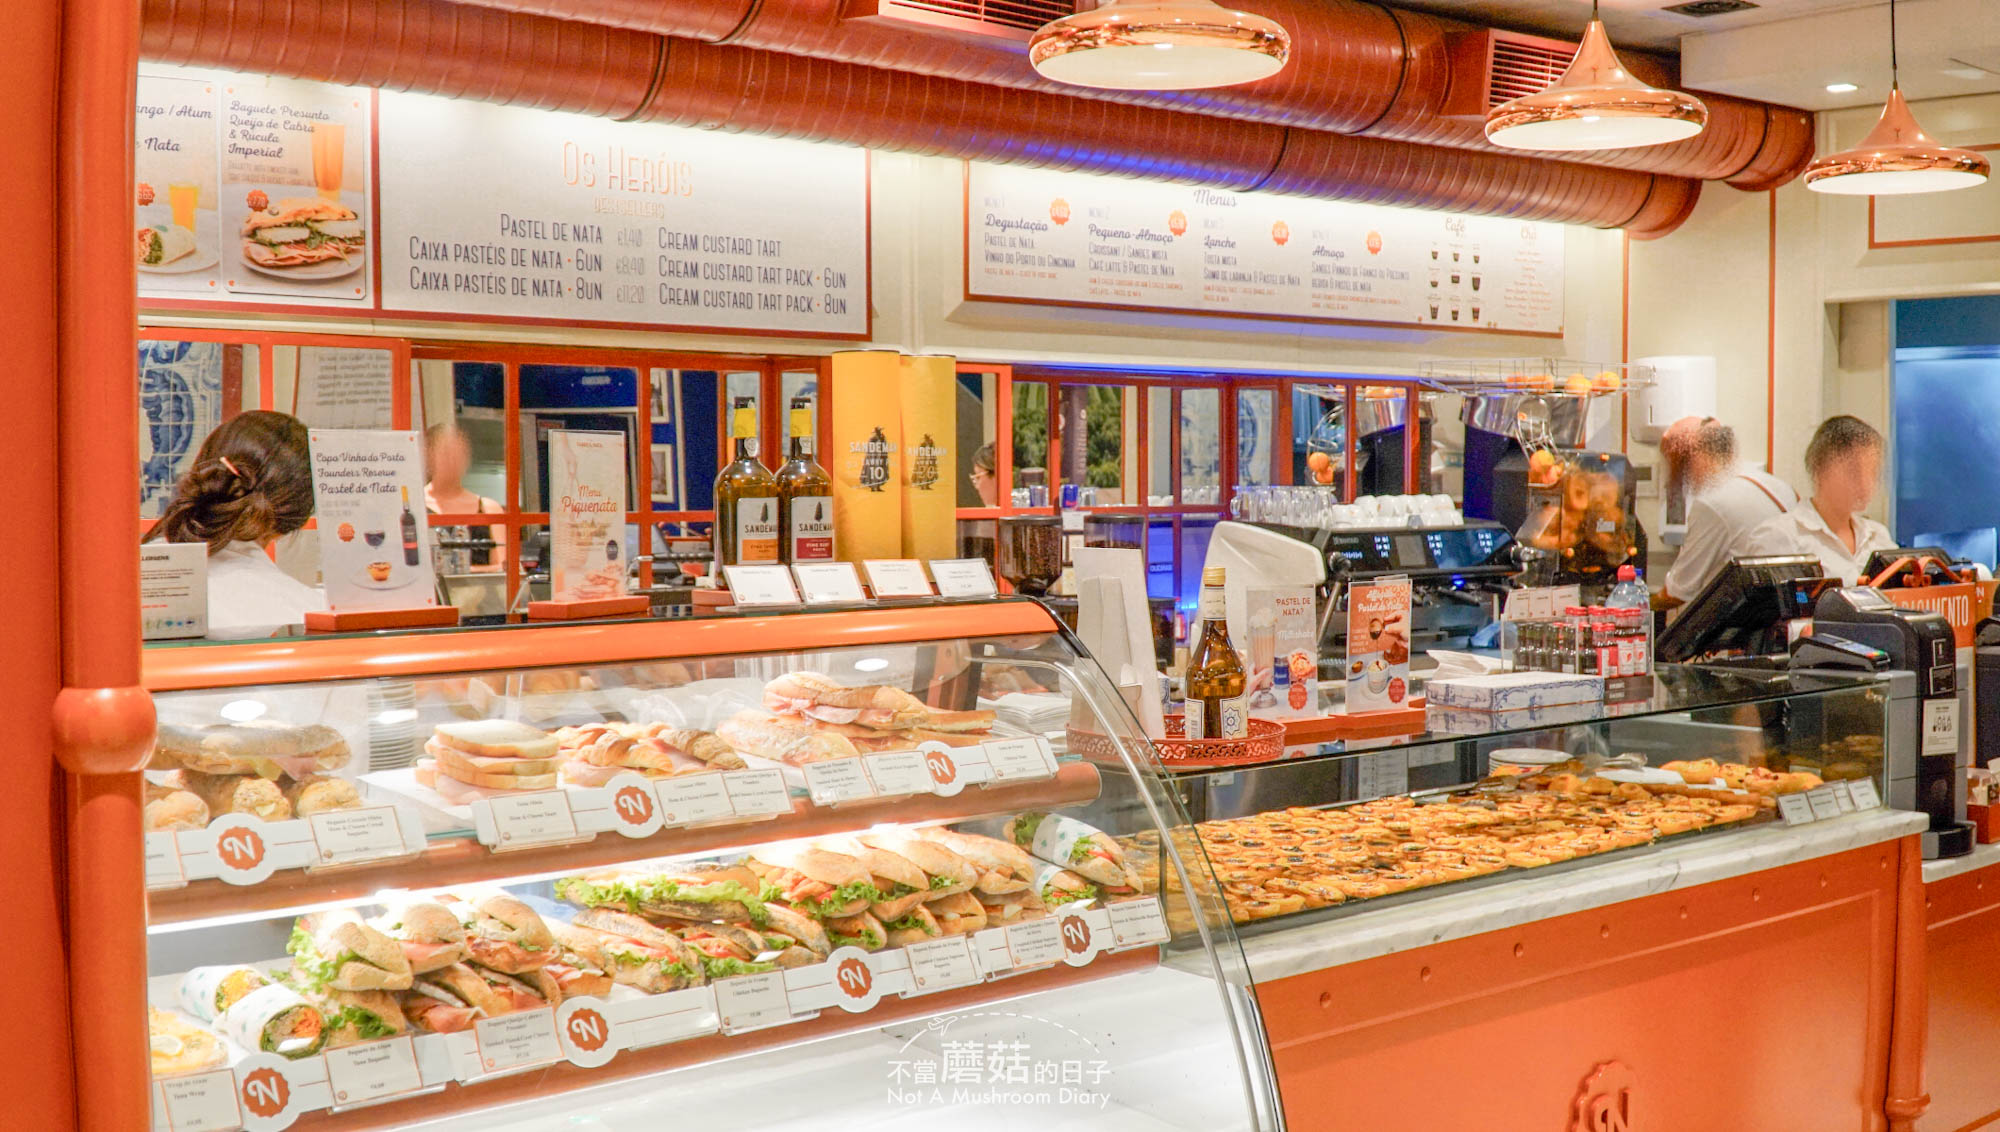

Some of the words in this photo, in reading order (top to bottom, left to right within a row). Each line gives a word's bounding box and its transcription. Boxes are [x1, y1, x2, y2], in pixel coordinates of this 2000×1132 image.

[176, 104, 213, 121] Atum
[230, 100, 277, 118] Baguete
[279, 106, 330, 123] Presunto
[230, 115, 263, 133] Queijo
[266, 119, 278, 131] de
[283, 120, 316, 135] Cabra
[144, 136, 182, 153] Nata
[229, 130, 238, 143] &
[228, 145, 283, 161] Imperial
[563, 141, 596, 189] OS
[608, 144, 694, 198] HERÓIS
[1194, 189, 1238, 208] Menus
[501, 213, 548, 241] PASTEL
[552, 222, 569, 242] DE
[573, 224, 603, 244] NATA
[985, 212, 1049, 233] Degustação
[617, 227, 643, 248] €1.40
[658, 227, 699, 252] CREAM
[703, 235, 752, 256] CUSTARD
[757, 240, 782, 258] TART
[985, 232, 1008, 248] PASTEL
[1009, 236, 1017, 248] DE
[1019, 237, 1035, 249] NATA
[1203, 236, 1237, 249] Lanche
[409, 236, 449, 262] CAIXA
[453, 241, 506, 267] PASTÉIS
[511, 247, 528, 267] DE
[532, 249, 563, 270] NATA
[985, 249, 1004, 264] VINHO
[1005, 253, 1014, 265] DO
[1016, 251, 1036, 266] PORTO
[1089, 242, 1120, 257] CROISSANT
[658, 255, 700, 280] CREAM
[703, 262, 753, 285] CUSTARD
[757, 268, 782, 287] TART
[786, 269, 813, 288] PACK
[824, 267, 848, 290] 6UN
[1130, 261, 1150, 275] PASTEL
[1161, 263, 1175, 276] NATA
[410, 266, 450, 292] CAIXA
[454, 271, 506, 295] PASTÉIS
[511, 276, 528, 297] DE
[532, 278, 563, 299] NATA
[576, 276, 603, 301] 8UN
[659, 282, 700, 307] CREAM
[703, 289, 753, 311] CUSTARD
[758, 293, 783, 312] TART
[786, 296, 814, 314] PACK
[824, 293, 848, 316] 8UN
[903, 446, 948, 457] ANDEMAN
[870, 466, 885, 480] 10
[318, 482, 355, 496] Pastel
[356, 483, 370, 495] de
[370, 483, 398, 495] Nata
[560, 496, 618, 518] Piquenata
[1276, 598, 1301, 607] PASTEL
[1302, 597, 1312, 605] DE
[1282, 608, 1305, 617] NATA?
